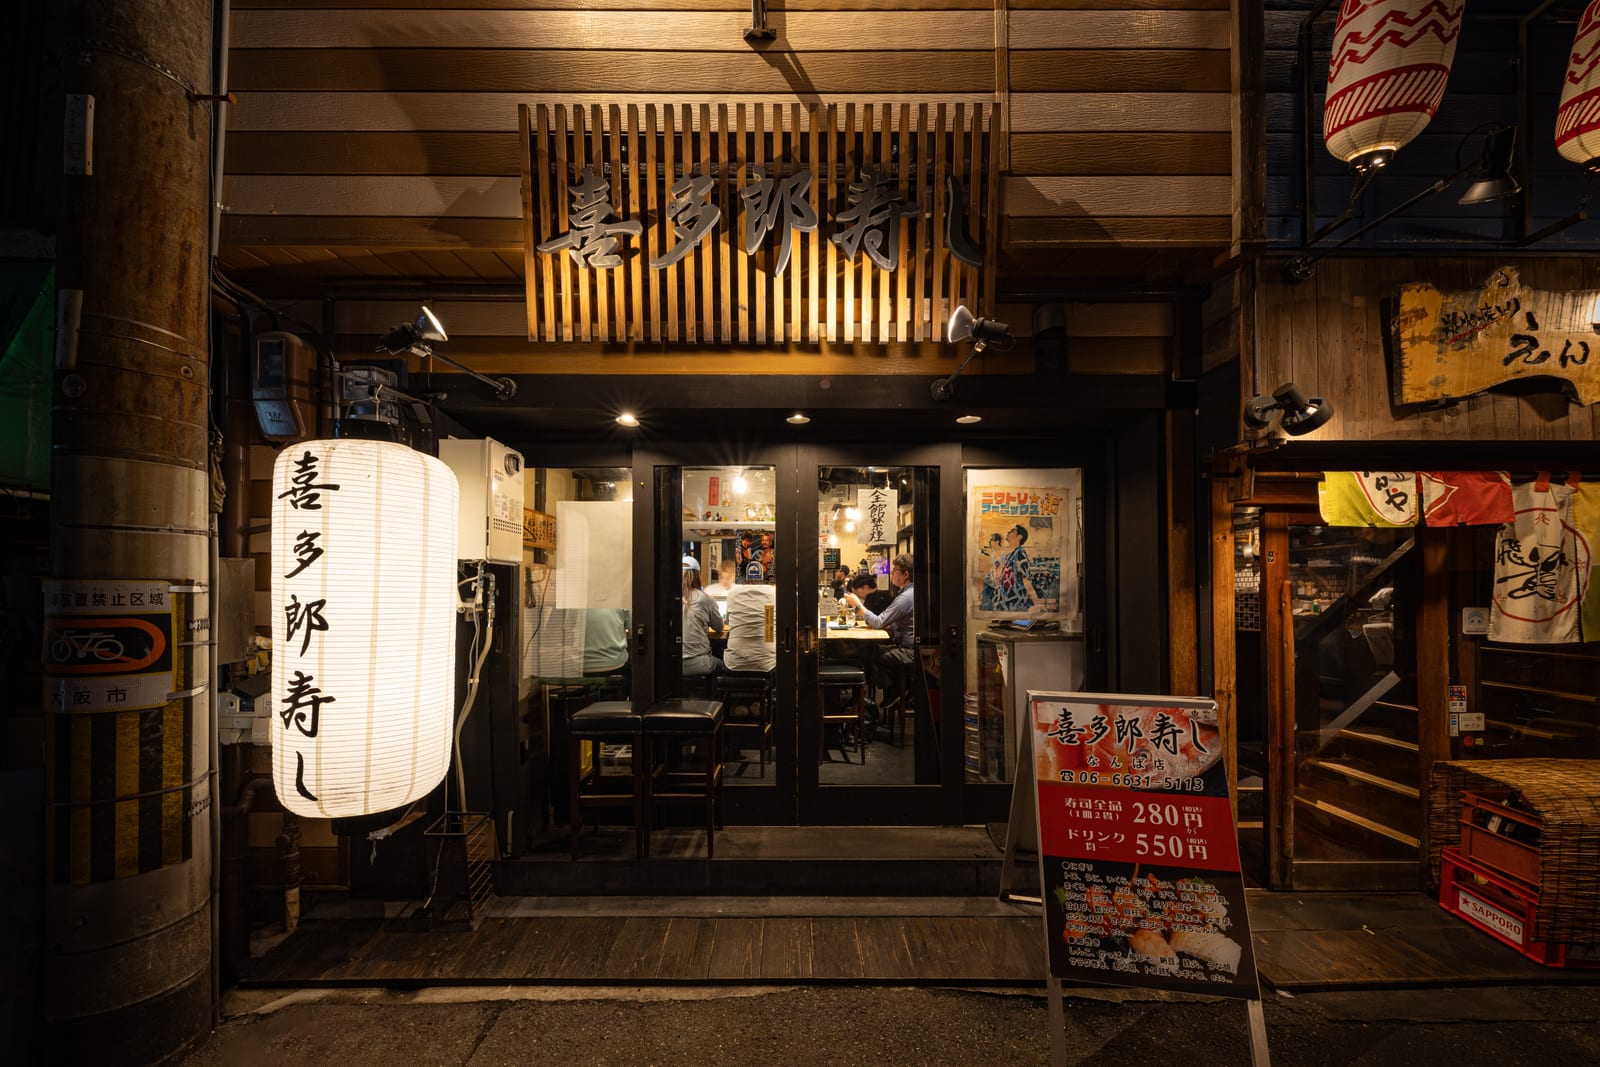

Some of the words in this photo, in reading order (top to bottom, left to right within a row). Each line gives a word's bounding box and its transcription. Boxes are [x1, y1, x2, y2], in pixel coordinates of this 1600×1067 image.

[536, 165, 983, 278] 喜多郎寿し
[868, 489, 888, 543] 全館禁煙
[278, 450, 340, 802] 喜多郎寿し
[1047, 708, 1208, 755] 喜多郎寿し
[1087, 755, 1165, 770] なんば店
[1079, 771, 1205, 792] 06-6631-5113
[1064, 797, 1123, 812] 寿司全品
[1067, 828, 1126, 843] ドリンク
[1471, 902, 1521, 935] SAPPORO
